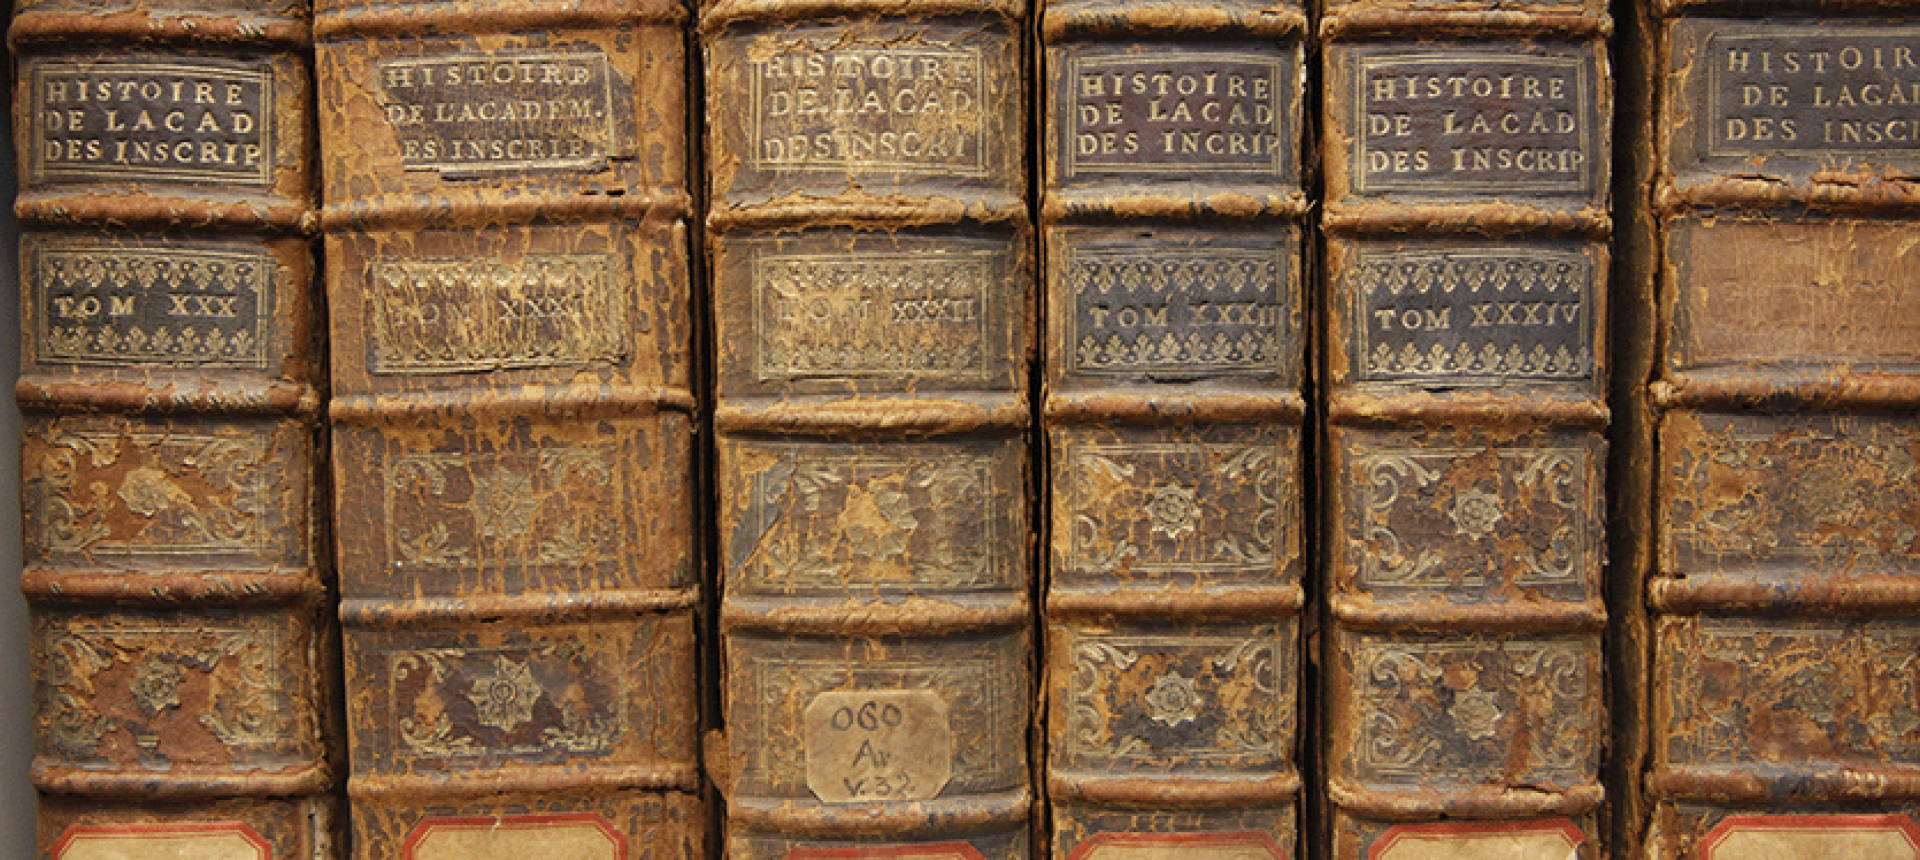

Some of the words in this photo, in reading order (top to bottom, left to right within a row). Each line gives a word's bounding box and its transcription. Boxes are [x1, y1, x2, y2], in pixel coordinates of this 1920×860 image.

[385, 63, 591, 88] HISTOIRE
[764, 53, 972, 83] HISTOIRE
[45, 80, 243, 105] HISTOIRE
[1080, 72, 1270, 99] HISTOIRE
[1371, 74, 1565, 101] HISTOIRE
[1742, 84, 1790, 107] DE
[45, 110, 85, 132] DE
[383, 104, 424, 124] DE
[1078, 104, 1123, 126] DE
[1367, 112, 1412, 136] DE
[1725, 118, 1798, 141] DES
[45, 139, 102, 162] DES
[113, 140, 261, 165] INSCRIP
[762, 132, 832, 162] DES
[1076, 131, 1139, 155] DES
[1161, 130, 1280, 154] INCRIP
[1366, 149, 1430, 173] DES
[1451, 149, 1585, 173] INSCRIP
[54, 295, 136, 318] TOM
[167, 294, 238, 317] XXX
[1089, 305, 1168, 329] TOM
[1374, 308, 1451, 330] TOM
[1469, 301, 1580, 327] XXXIV
[830, 700, 903, 732] 060
